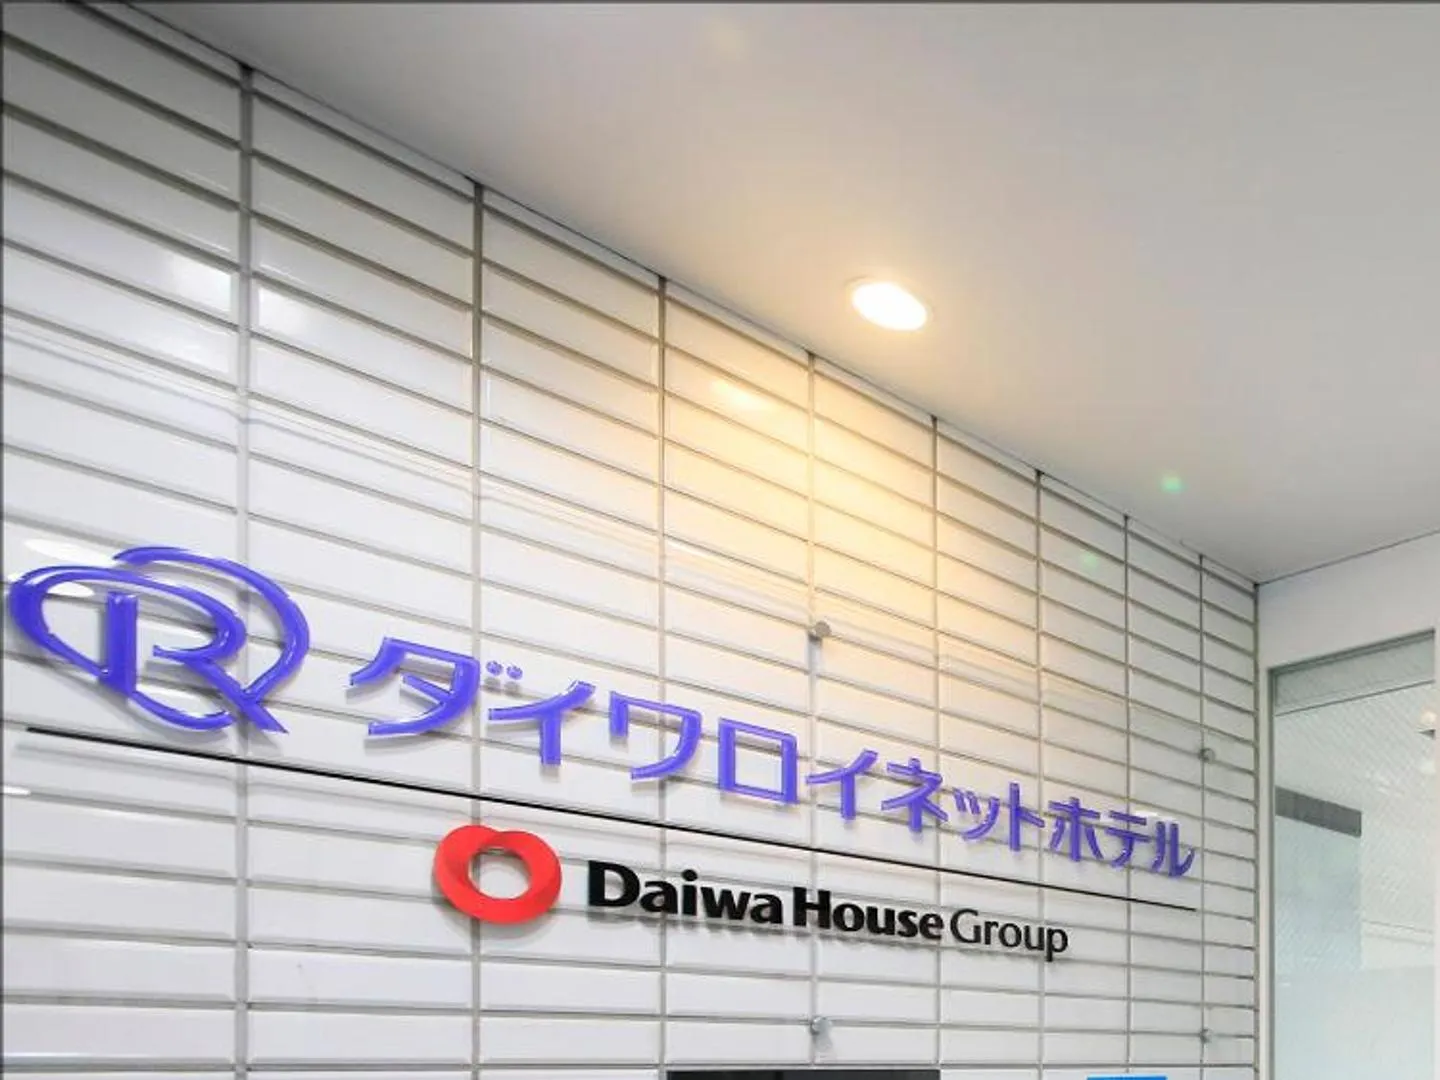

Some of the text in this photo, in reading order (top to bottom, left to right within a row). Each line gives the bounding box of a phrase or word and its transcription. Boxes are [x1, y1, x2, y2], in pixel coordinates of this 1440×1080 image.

[350, 637, 1195, 878] ダイワロイネットホテル
[587, 860, 1069, 961] Daiwa House Group
